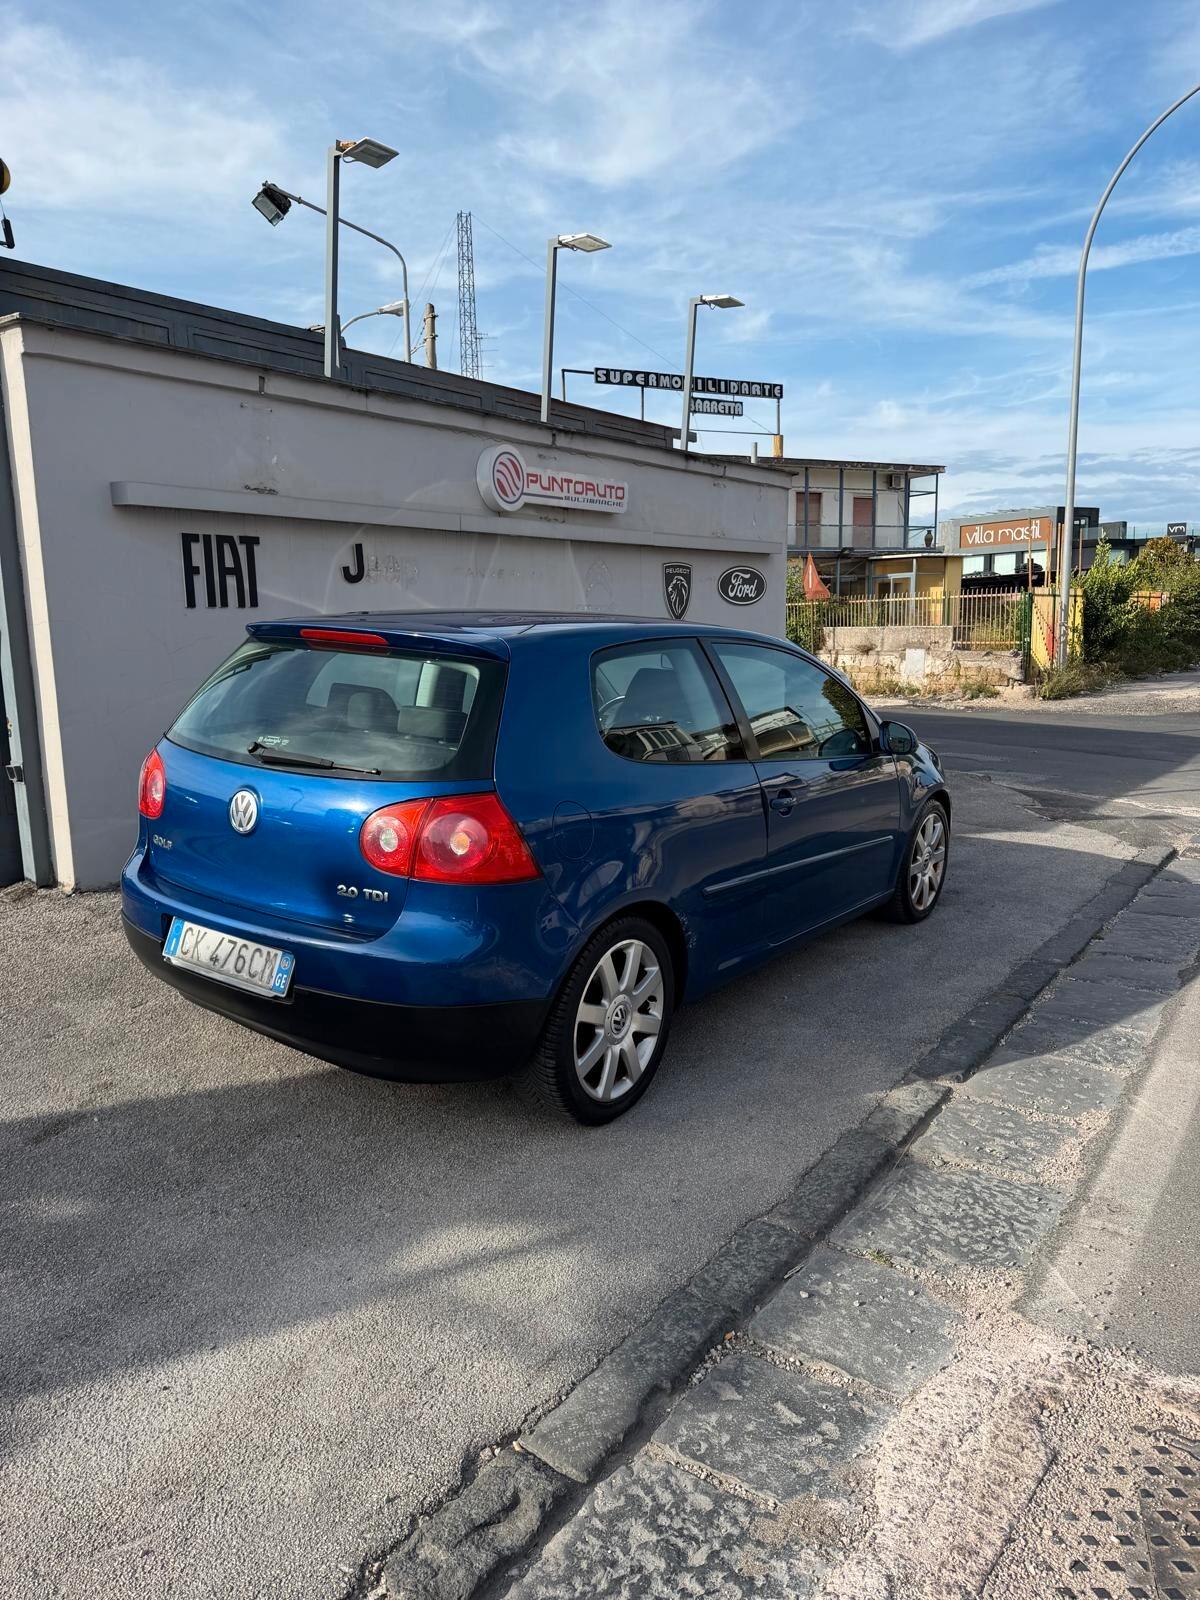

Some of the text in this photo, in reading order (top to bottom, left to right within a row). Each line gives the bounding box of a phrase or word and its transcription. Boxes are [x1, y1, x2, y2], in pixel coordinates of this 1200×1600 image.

[526, 473, 625, 500] PUNTOAUTO
[966, 526, 995, 545] villa
[181, 532, 260, 609] FIAT
[728, 571, 758, 598] Ford
[362, 888, 389, 903] TDI
[275, 973, 287, 989] GE
